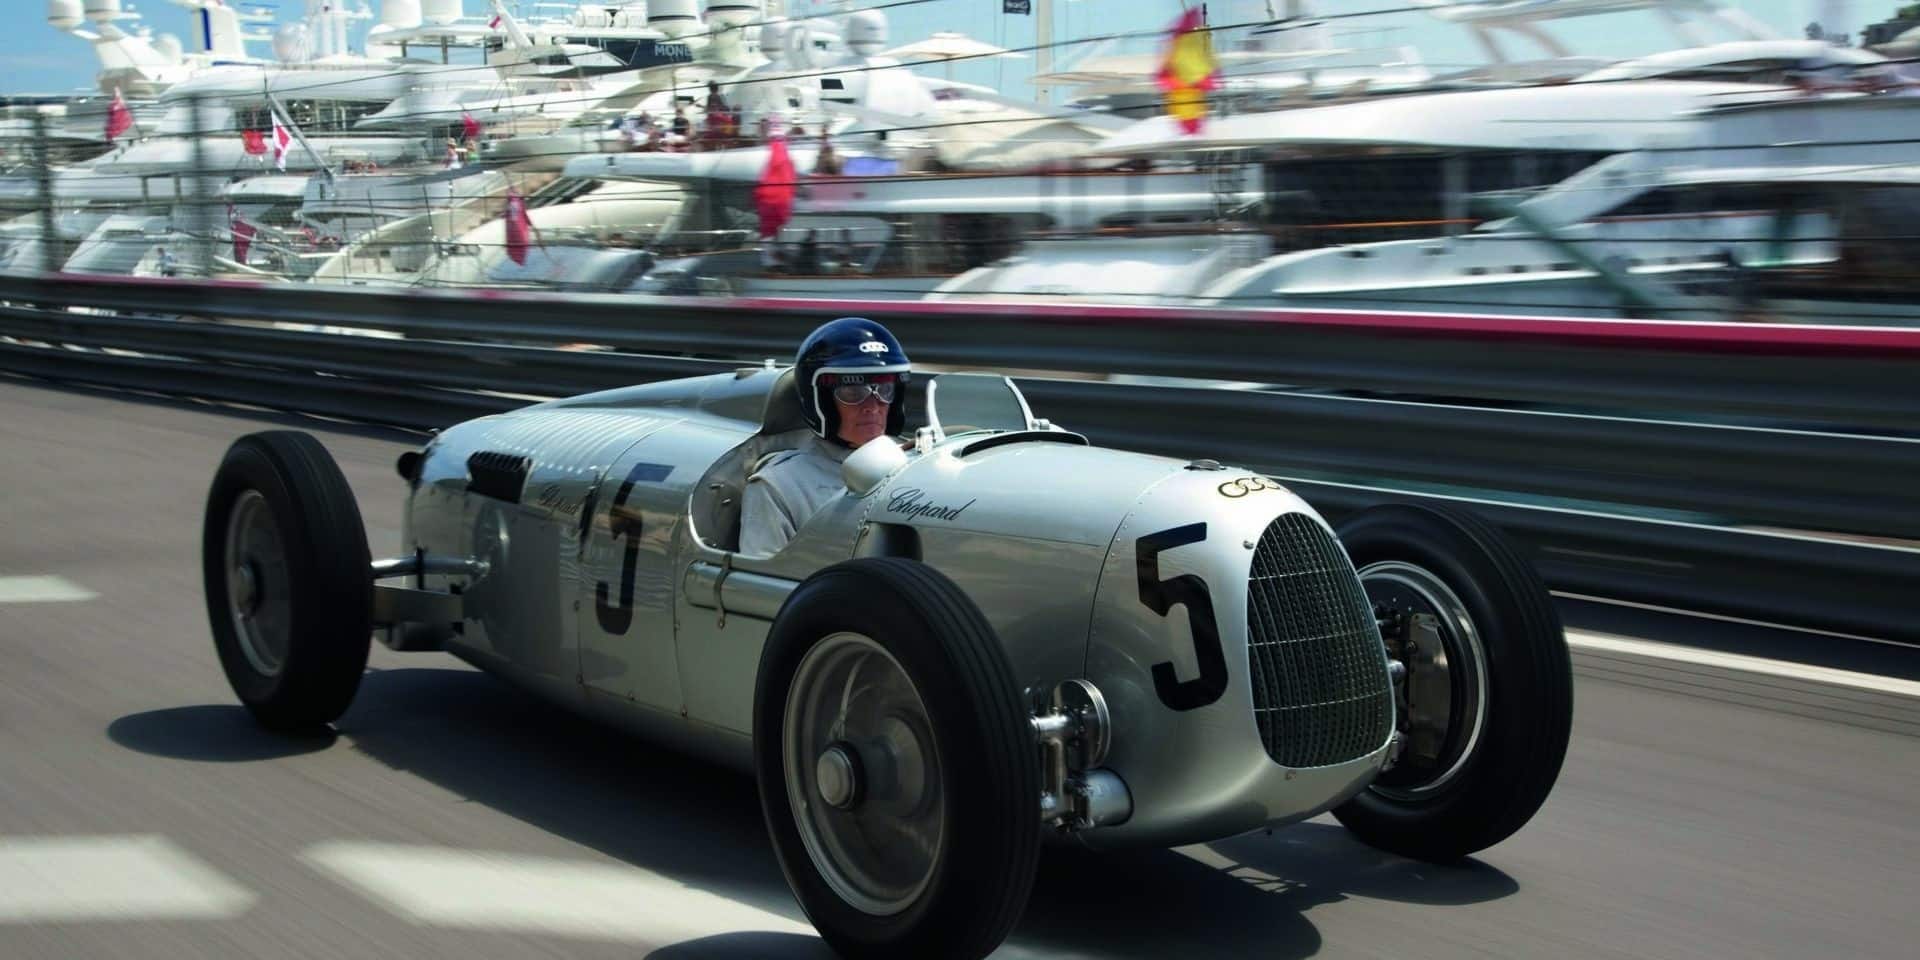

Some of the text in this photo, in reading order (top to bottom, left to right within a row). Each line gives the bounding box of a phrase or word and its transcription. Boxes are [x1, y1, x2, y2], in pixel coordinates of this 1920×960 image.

[596, 462, 675, 636] 5
[887, 486, 976, 521] Chopard
[1135, 522, 1229, 711] 5
